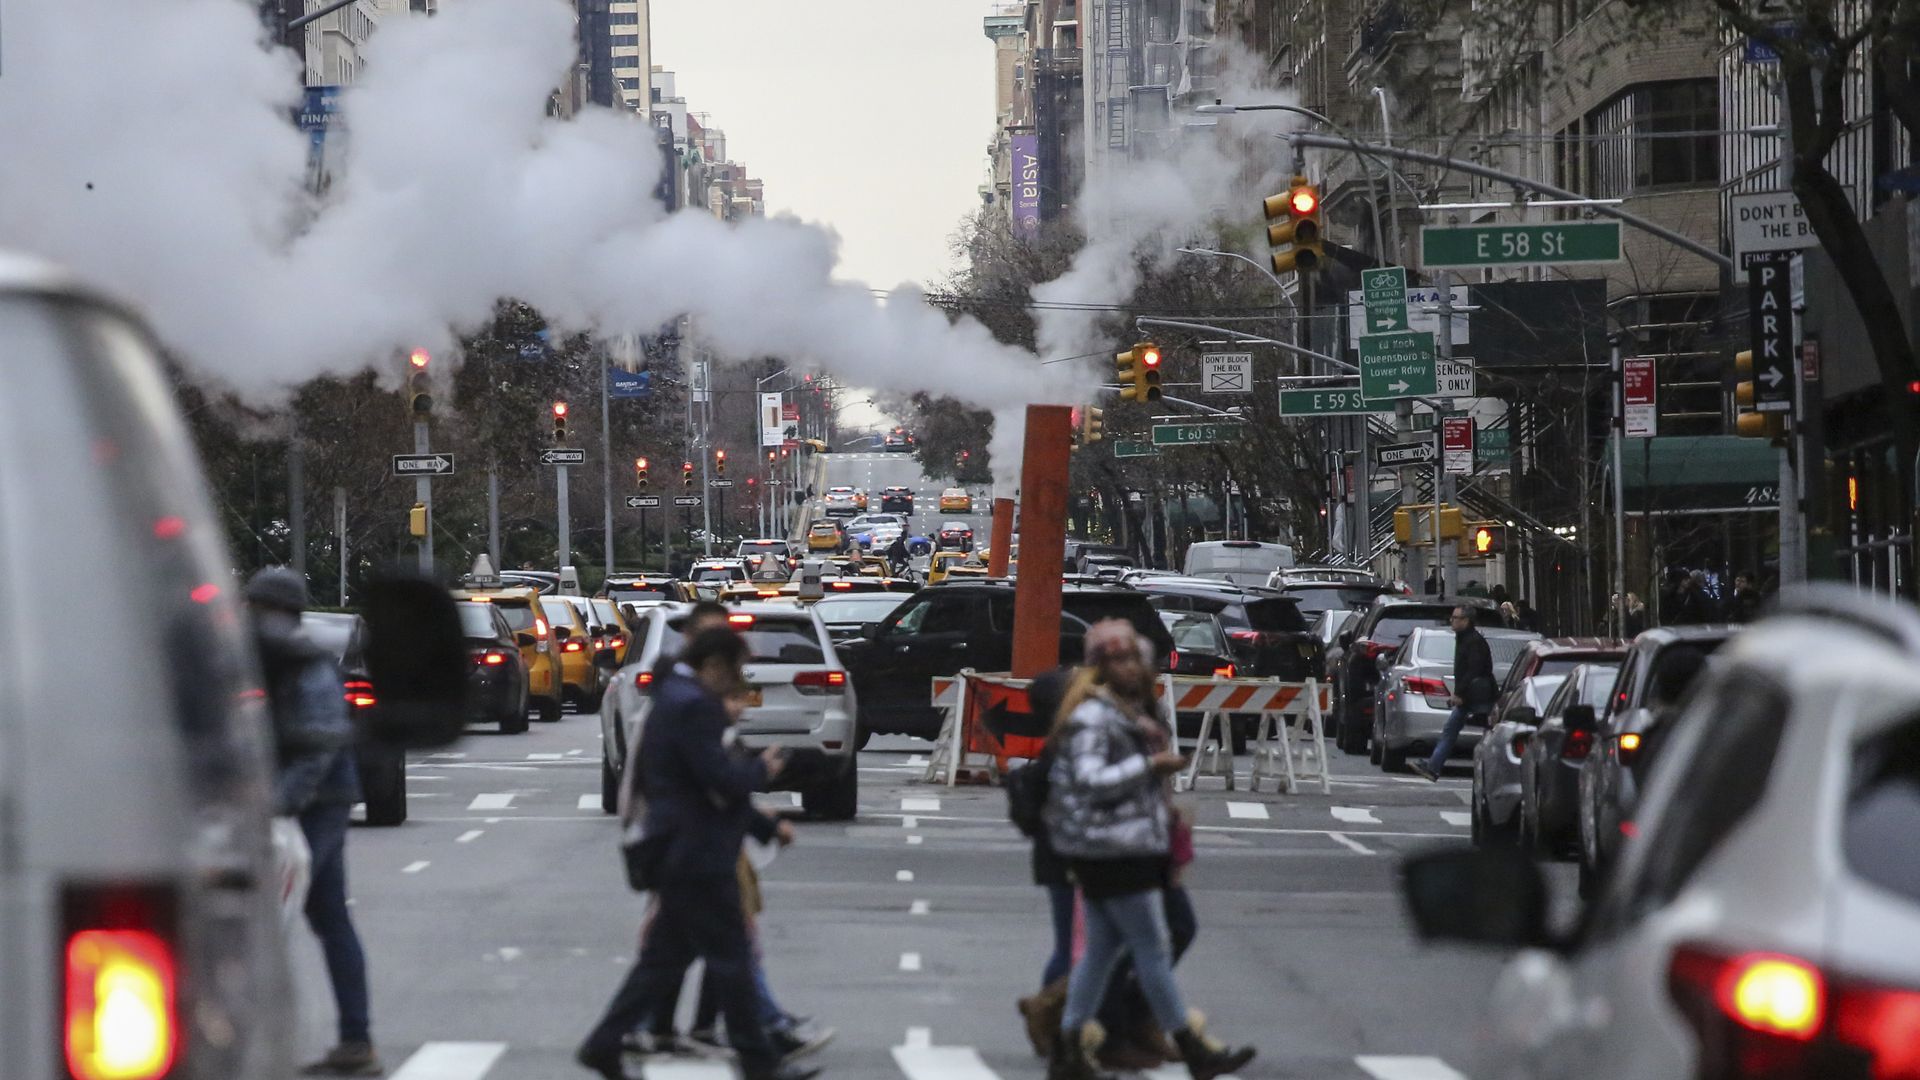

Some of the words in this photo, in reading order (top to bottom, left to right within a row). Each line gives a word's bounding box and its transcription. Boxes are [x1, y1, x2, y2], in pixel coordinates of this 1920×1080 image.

[1022, 154, 1038, 198] Asia
[1740, 204, 1786, 221] DON'T
[1760, 223, 1791, 238] THE
[1477, 234, 1490, 257] E
[1502, 232, 1530, 257] 58
[1541, 231, 1565, 256] St
[1431, 293, 1458, 302] Ae
[1761, 267, 1779, 358] PARK
[1379, 341, 1389, 350] Ed
[1393, 338, 1415, 348] Koch
[1227, 355, 1249, 363] BLOCK
[1364, 352, 1418, 364] Queensboro
[1371, 366, 1397, 377] Lower
[1401, 365, 1426, 375] Rdwy
[1448, 380, 1470, 391] ONLY
[1314, 395, 1322, 409] E
[1329, 394, 1346, 409] 59
[1178, 429, 1184, 440] E
[1188, 429, 1202, 440] 60
[1480, 432, 1494, 443] 59
[1386, 451, 1404, 461] ONE
[1412, 447, 1431, 458] WAY
[427, 460, 444, 468] WAY
